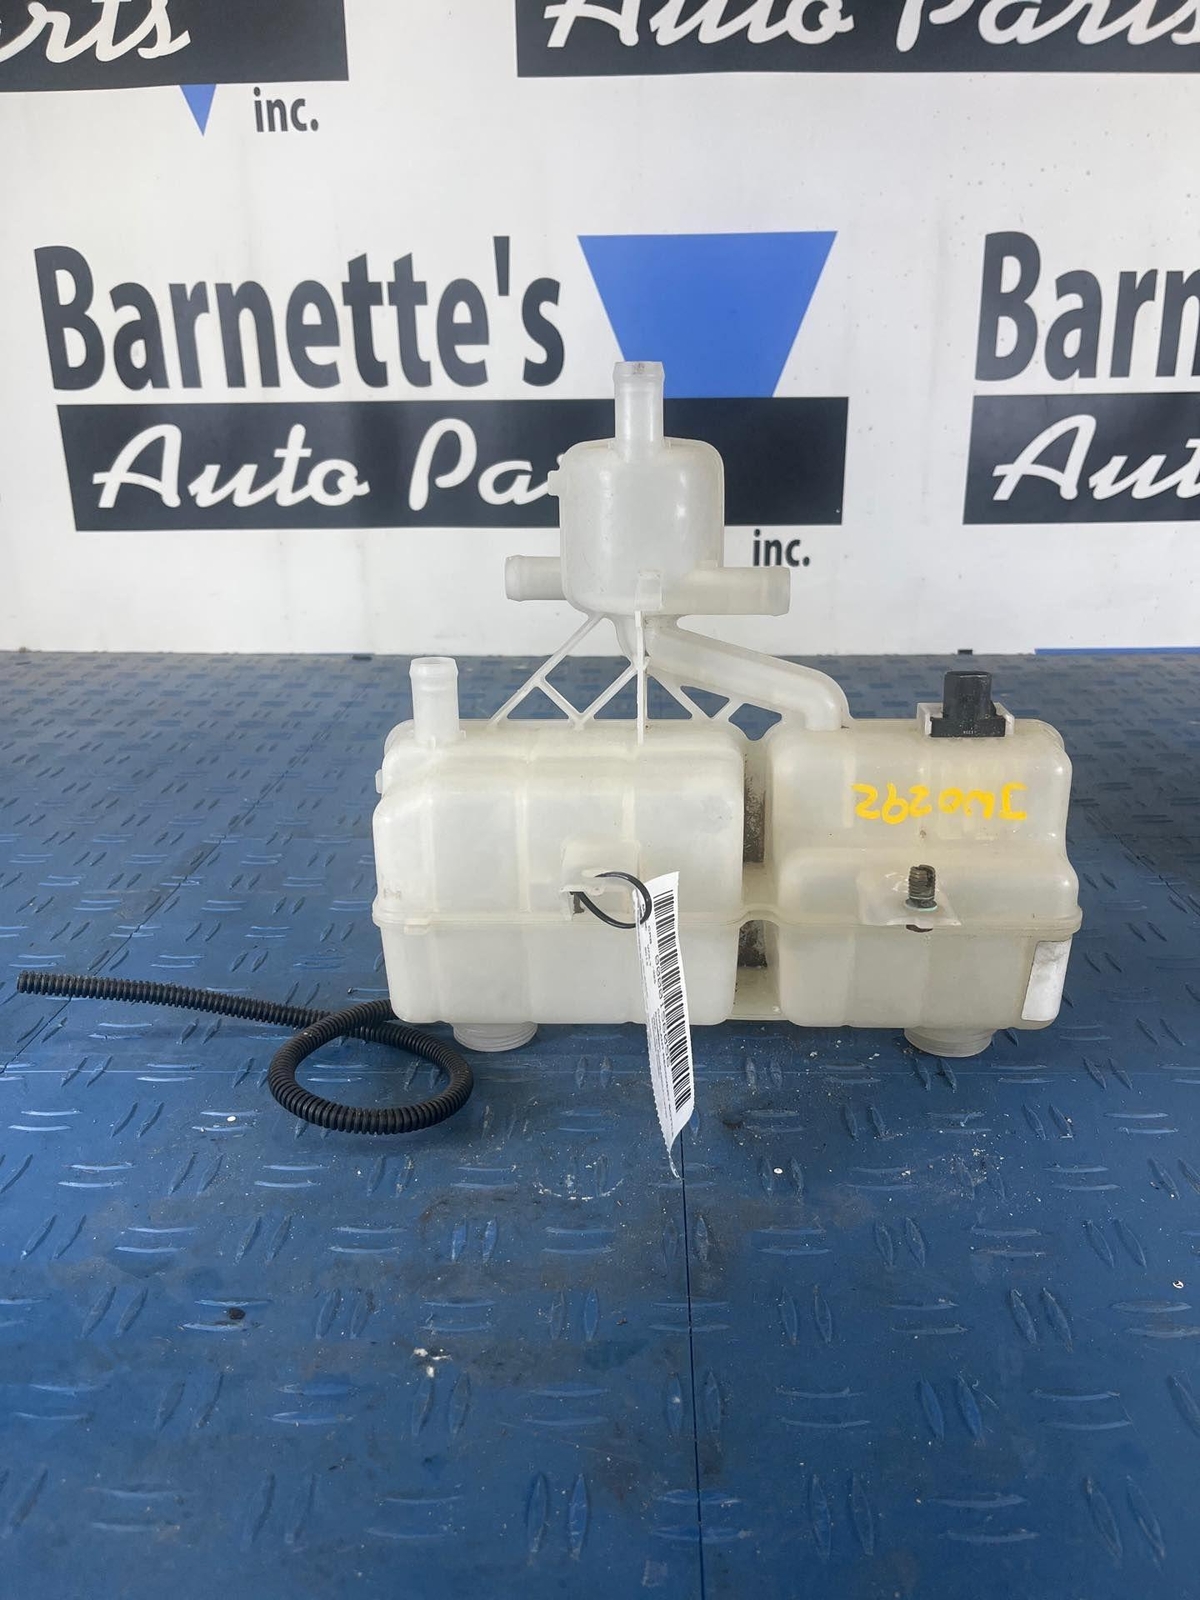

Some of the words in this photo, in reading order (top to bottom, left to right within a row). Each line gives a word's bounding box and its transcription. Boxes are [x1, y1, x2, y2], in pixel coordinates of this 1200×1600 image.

[0, 0, 191, 63] rts
[253, 86, 319, 133] inc.
[34, 236, 565, 391] Barnette's
[975, 231, 1200, 381] Barn
[92, 424, 370, 509] Auto
[408, 418, 562, 511] Pa
[753, 529, 810, 567] inc.
